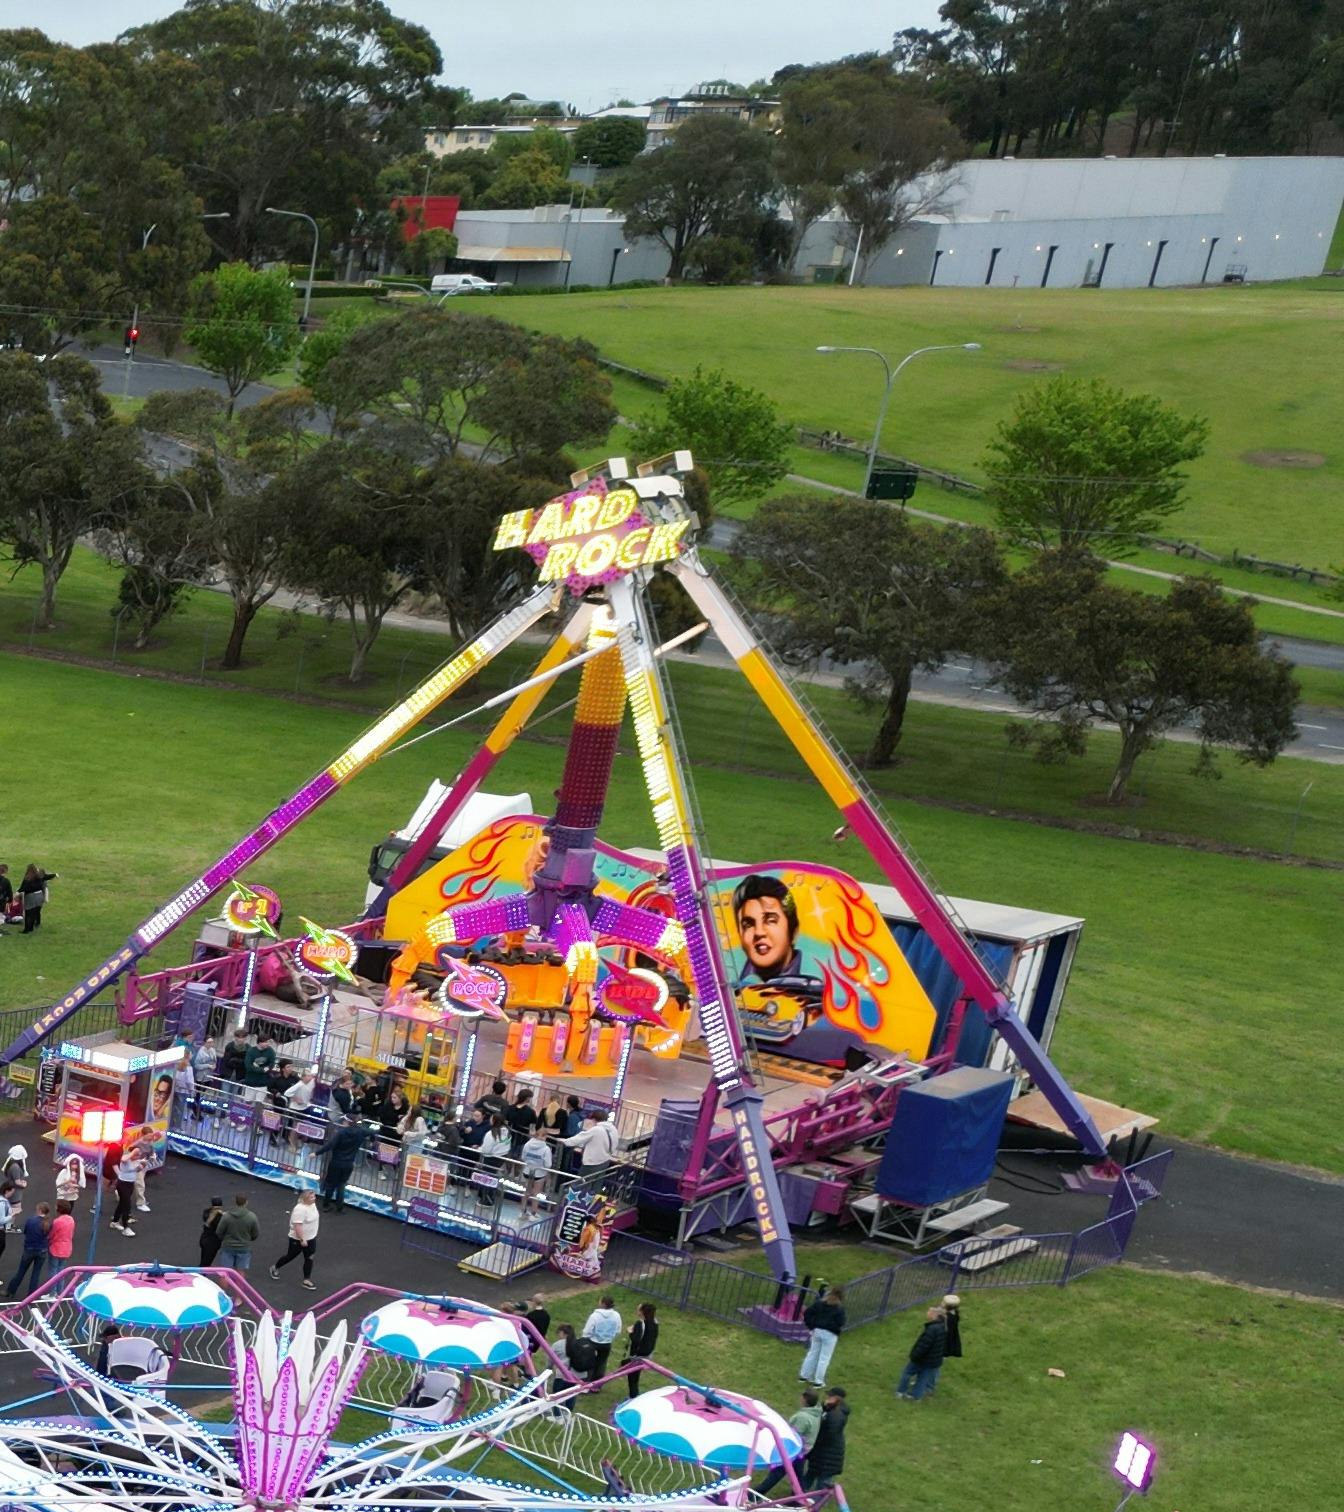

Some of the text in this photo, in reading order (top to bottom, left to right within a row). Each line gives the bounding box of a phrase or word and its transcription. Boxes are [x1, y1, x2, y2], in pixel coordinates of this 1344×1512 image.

[493, 488, 638, 552] HARD
[538, 519, 691, 583] ROCK
[452, 981, 498, 996] ROCK
